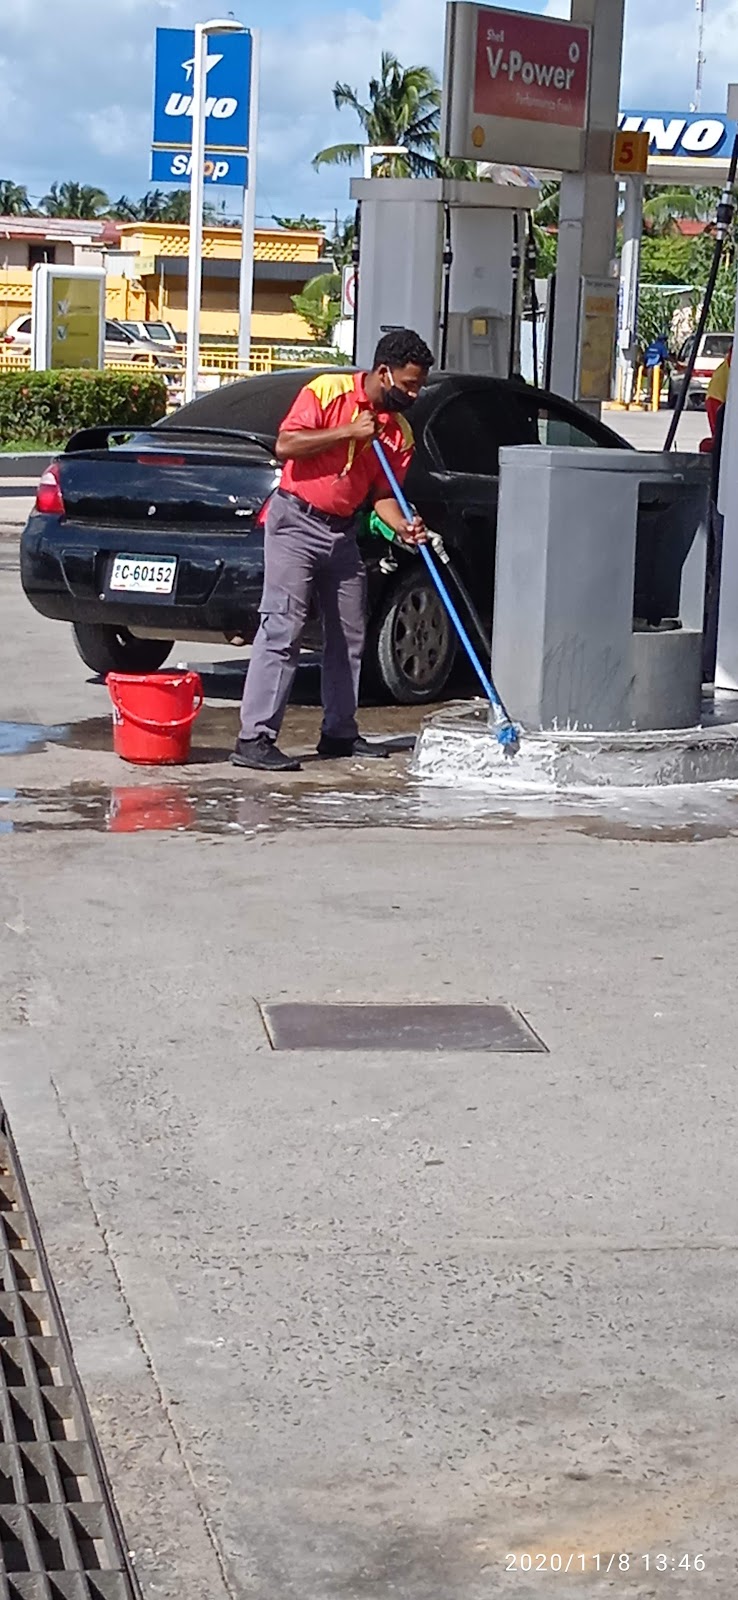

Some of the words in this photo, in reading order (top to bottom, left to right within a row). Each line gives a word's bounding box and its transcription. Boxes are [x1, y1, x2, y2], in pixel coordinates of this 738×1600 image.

[486, 46, 575, 90] V-Power
[164, 93, 238, 118] UNO
[618, 142, 634, 164] 5
[121, 565, 172, 583] C-60152
